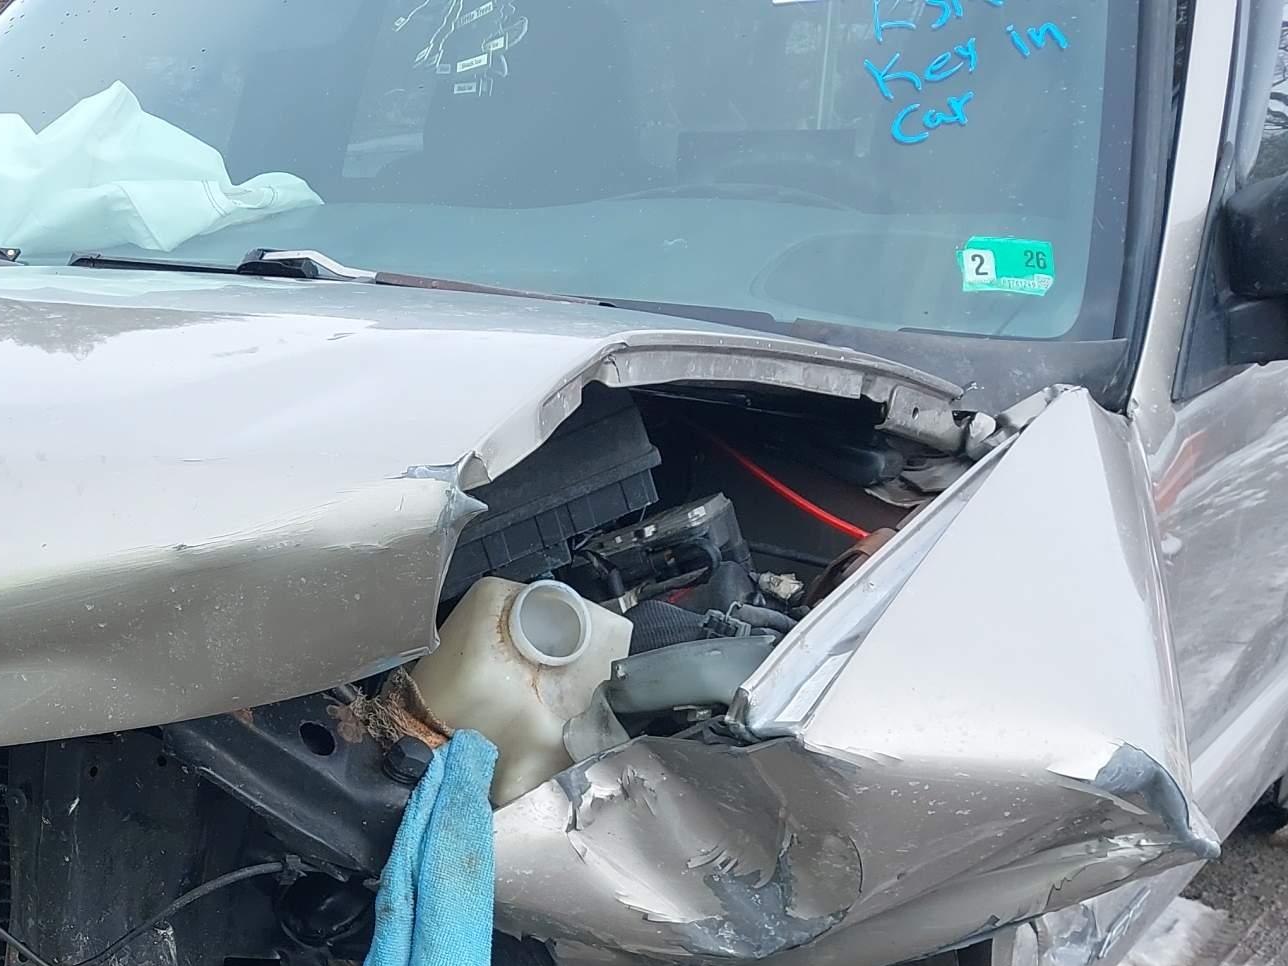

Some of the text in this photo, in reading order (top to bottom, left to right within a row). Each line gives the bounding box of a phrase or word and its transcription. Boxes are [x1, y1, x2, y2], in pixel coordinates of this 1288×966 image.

[864, 37, 977, 101] Key
[1006, 21, 1069, 58] in
[890, 91, 974, 145] Car
[970, 253, 989, 276] 2
[1023, 249, 1048, 270] 26
